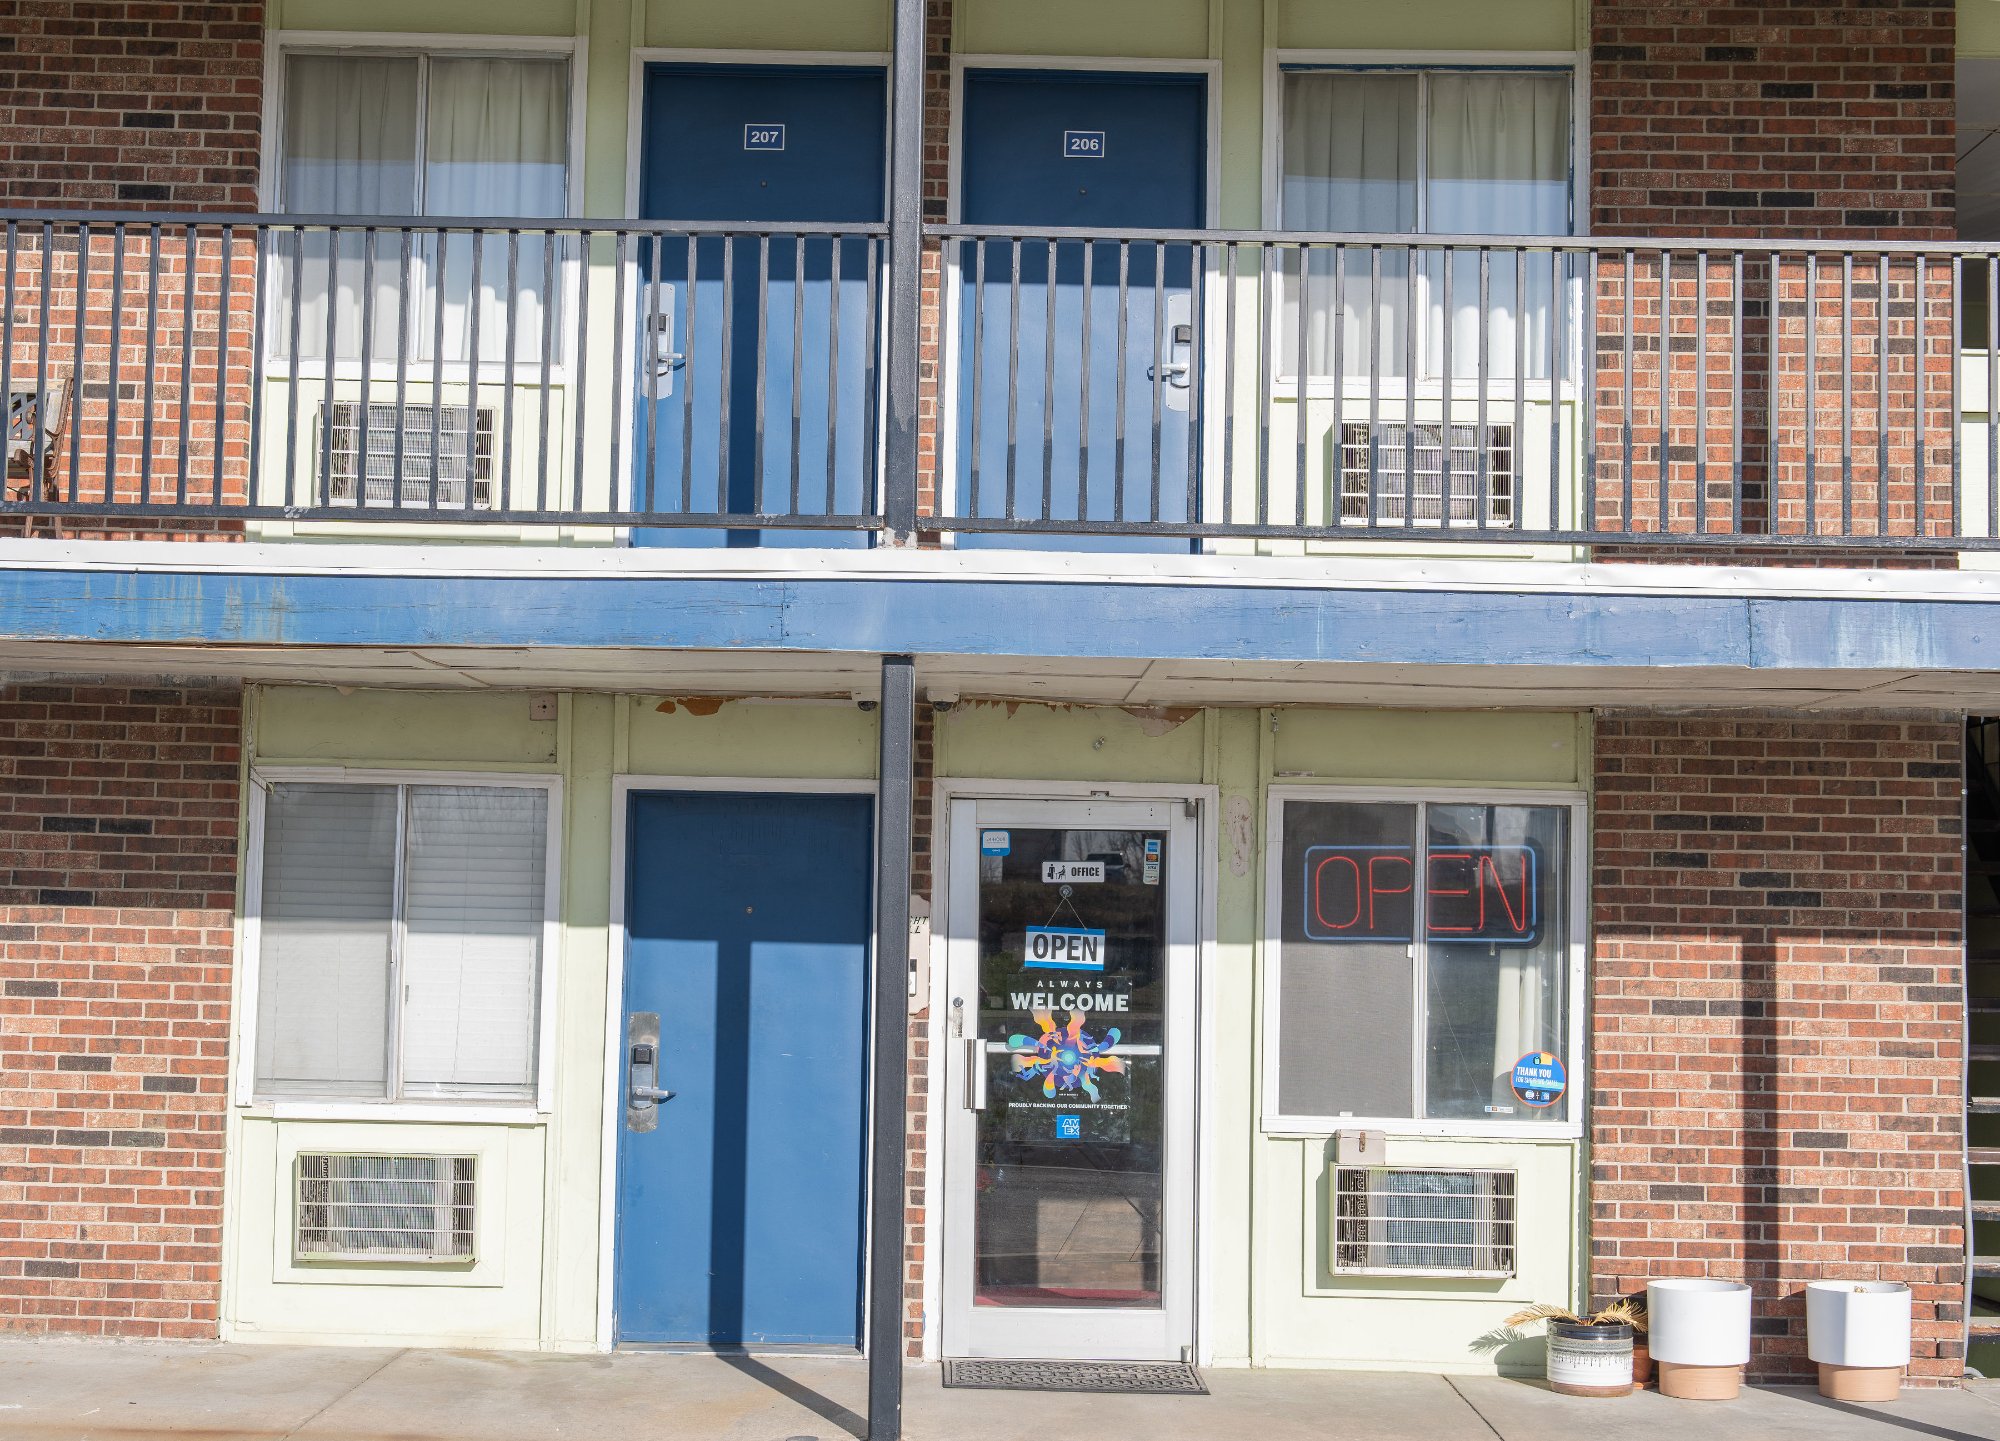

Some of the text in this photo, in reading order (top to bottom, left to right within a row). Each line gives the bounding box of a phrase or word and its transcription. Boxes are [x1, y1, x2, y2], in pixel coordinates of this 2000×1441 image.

[751, 131, 779, 143] 207
[1071, 138, 1099, 150] 206
[1071, 866, 1100, 877] OFFICE
[1315, 854, 1526, 932] OPEN
[1032, 933, 1098, 962] OPEN
[1037, 980, 1103, 988] ALWAYS
[1010, 992, 1129, 1012] WELCOME
[1516, 1066, 1552, 1079] THANK YOU
